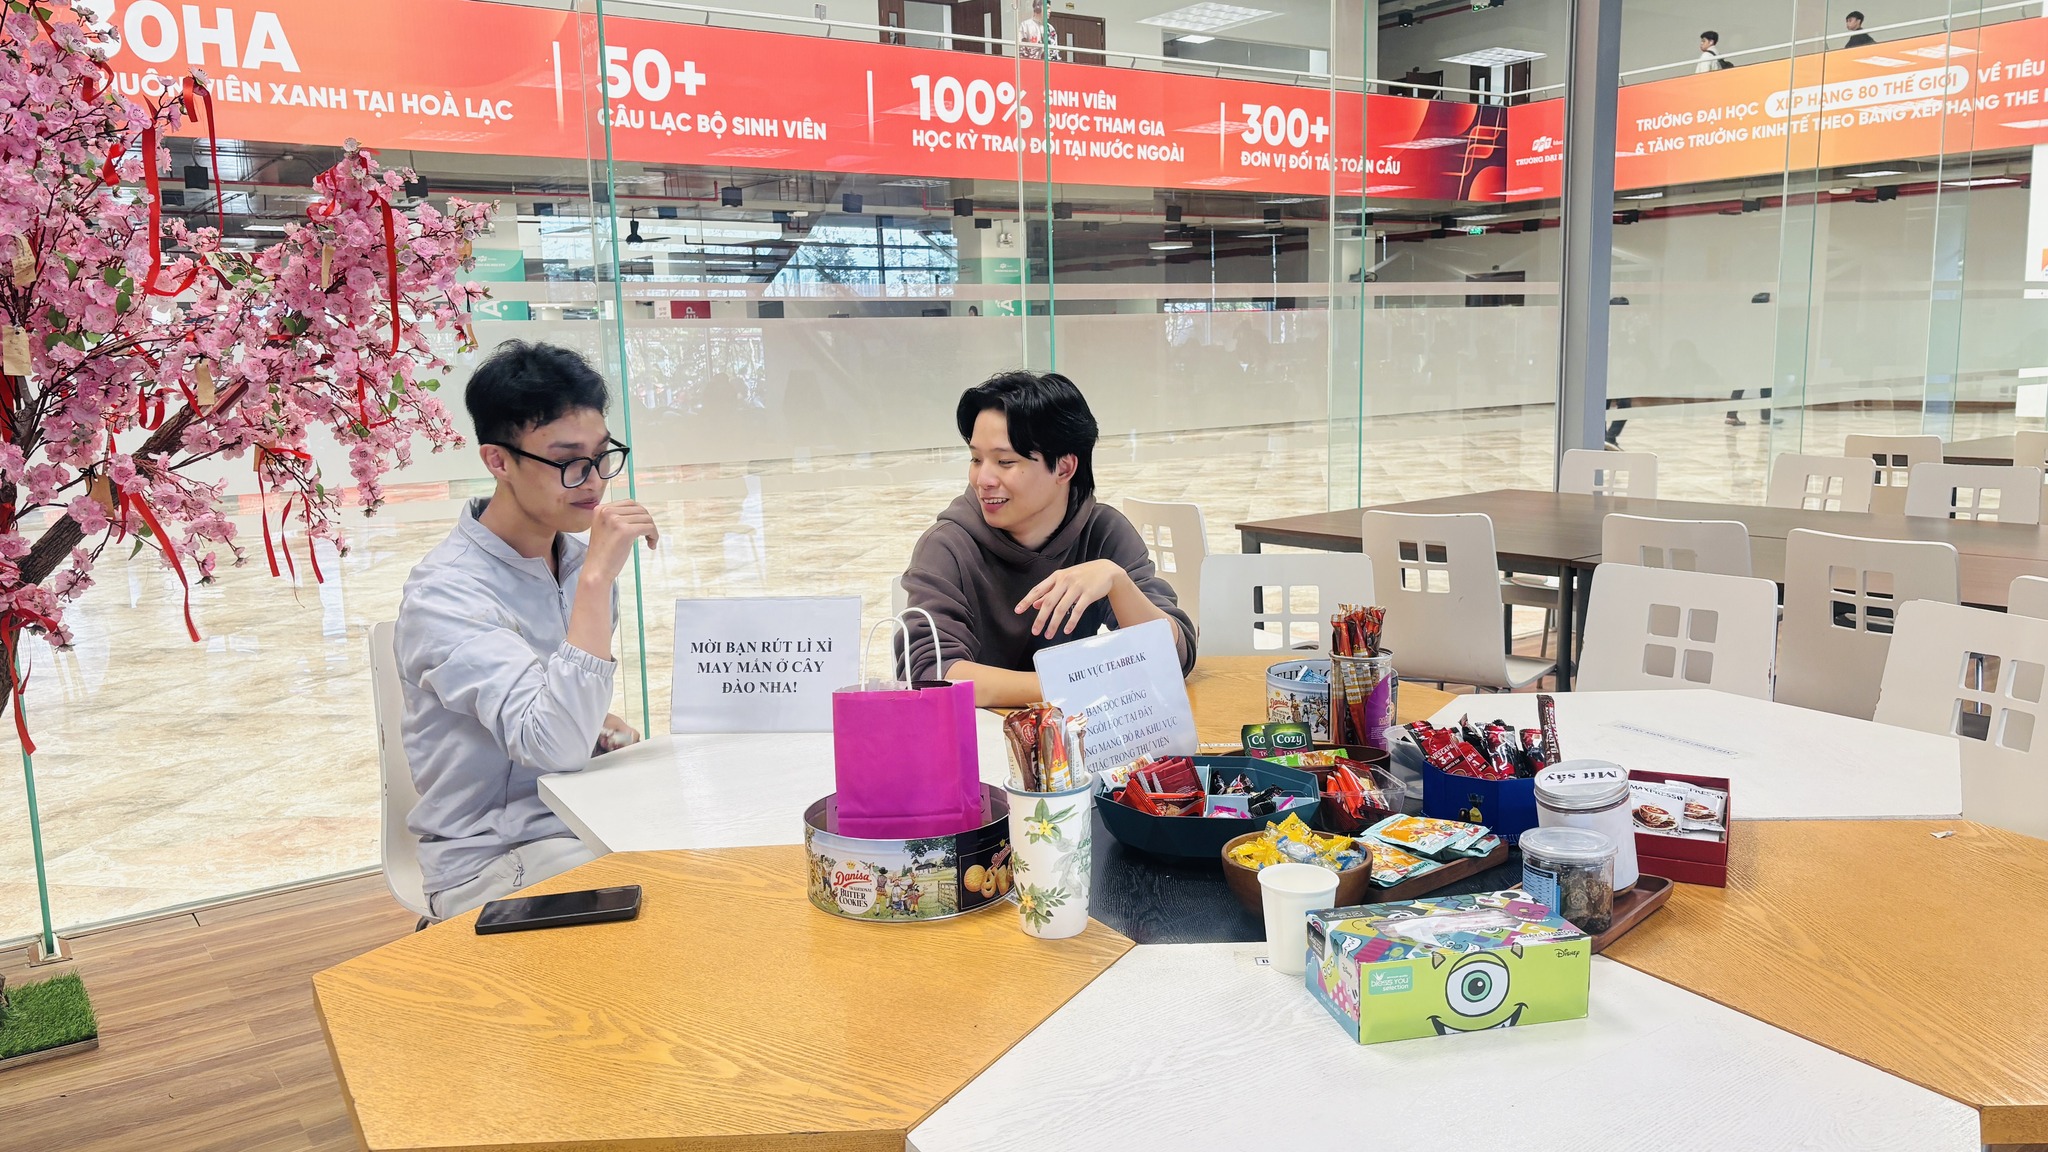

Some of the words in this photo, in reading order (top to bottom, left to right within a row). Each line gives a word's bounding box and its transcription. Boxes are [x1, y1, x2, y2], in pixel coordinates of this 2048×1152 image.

[596, 45, 706, 102] 50+
[269, 83, 347, 110] XANH
[353, 89, 395, 118] TẠI
[401, 91, 460, 117] HOÀ
[465, 97, 514, 125] LẠC
[911, 75, 1033, 129] 100%
[1043, 90, 1079, 107] SINH
[1082, 90, 1116, 111] VIÊN
[1636, 112, 1693, 132] TRƯỜNG
[1697, 107, 1722, 125] ĐẠI
[1725, 101, 1759, 121] HỌC
[1775, 90, 1803, 112] XẾP
[1807, 87, 1854, 108] HẠNG
[1858, 84, 1879, 99] 80
[1884, 73, 1914, 96] THẾ
[1918, 72, 1957, 91] GIỚI
[1977, 61, 2001, 84] VỀ
[2005, 58, 2046, 79] TIÊU
[598, 104, 644, 129] CÂU
[650, 111, 692, 136] LẠC
[697, 111, 727, 139] BỘ
[732, 116, 778, 138] SINH
[783, 117, 827, 140] VIÊN
[1043, 113, 1090, 134] ĐƯỢC
[1094, 116, 1135, 134] THAM
[1139, 119, 1165, 137] GIA
[1241, 103, 1329, 148] 300+
[1635, 142, 1645, 155] &
[1648, 137, 1685, 154] TĂNG
[1688, 127, 1749, 147] TRƯỞNG
[1752, 123, 1788, 140] KINH
[1791, 113, 1808, 133] TẾ
[1812, 113, 1854, 131] THEO
[1946, 95, 2000, 117] HẠNG
[2004, 90, 2039, 107] THE
[912, 129, 951, 152] HỌC
[956, 129, 978, 150] KỲ
[982, 135, 1026, 153] TRAO
[1063, 139, 1086, 161] TẠI
[1090, 139, 1134, 159] NƯỚC
[1137, 143, 1184, 162] NGOÀI
[1240, 150, 1270, 168] ĐƠN
[1274, 153, 1286, 172] VỊ
[1289, 150, 1312, 170] ĐỐI
[1341, 155, 1374, 173] TOÀN
[1376, 155, 1400, 175] CẦU
[690, 638, 722, 654] MỜI
[726, 641, 757, 656] BẠN
[761, 637, 792, 653] RÚT
[797, 638, 812, 653] LÌ
[816, 637, 832, 653] XÌ
[697, 661, 732, 673] MAY
[737, 658, 772, 673] MẮN
[776, 658, 788, 673] Ở
[791, 658, 824, 673] CÂY
[1068, 668, 1087, 683] KHU
[1087, 663, 1104, 678] VỰC
[1105, 652, 1147, 672] TEABREAK
[722, 679, 755, 693] ĐÀO
[759, 681, 797, 693] NHA!
[1085, 704, 1103, 718] BẠN
[1103, 698, 1120, 712] ĐỌC
[1120, 690, 1147, 706] KHÔNG
[1124, 712, 1138, 724] TẠI
[1139, 706, 1154, 718] ĐÂY
[1099, 736, 1123, 753] MANG
[1135, 728, 1146, 739] RA
[1146, 722, 1162, 733] KHU
[1162, 716, 1178, 729] VỰC
[1252, 735, 1266, 745] Co
[1276, 734, 1302, 745] Cozy
[1086, 757, 1109, 774] KHÁC
[1109, 749, 1135, 766] TRONG
[1136, 742, 1152, 756] THƯ
[1152, 736, 1171, 749] VIỆN
[1545, 772, 1576, 783] sấy
[1629, 784, 1683, 801] MAXPRESSO
[833, 869, 871, 886] Danisa
[839, 896, 868, 908] COOKIES
[840, 888, 866, 900] BUTTER
[1554, 948, 1581, 958] Disney
